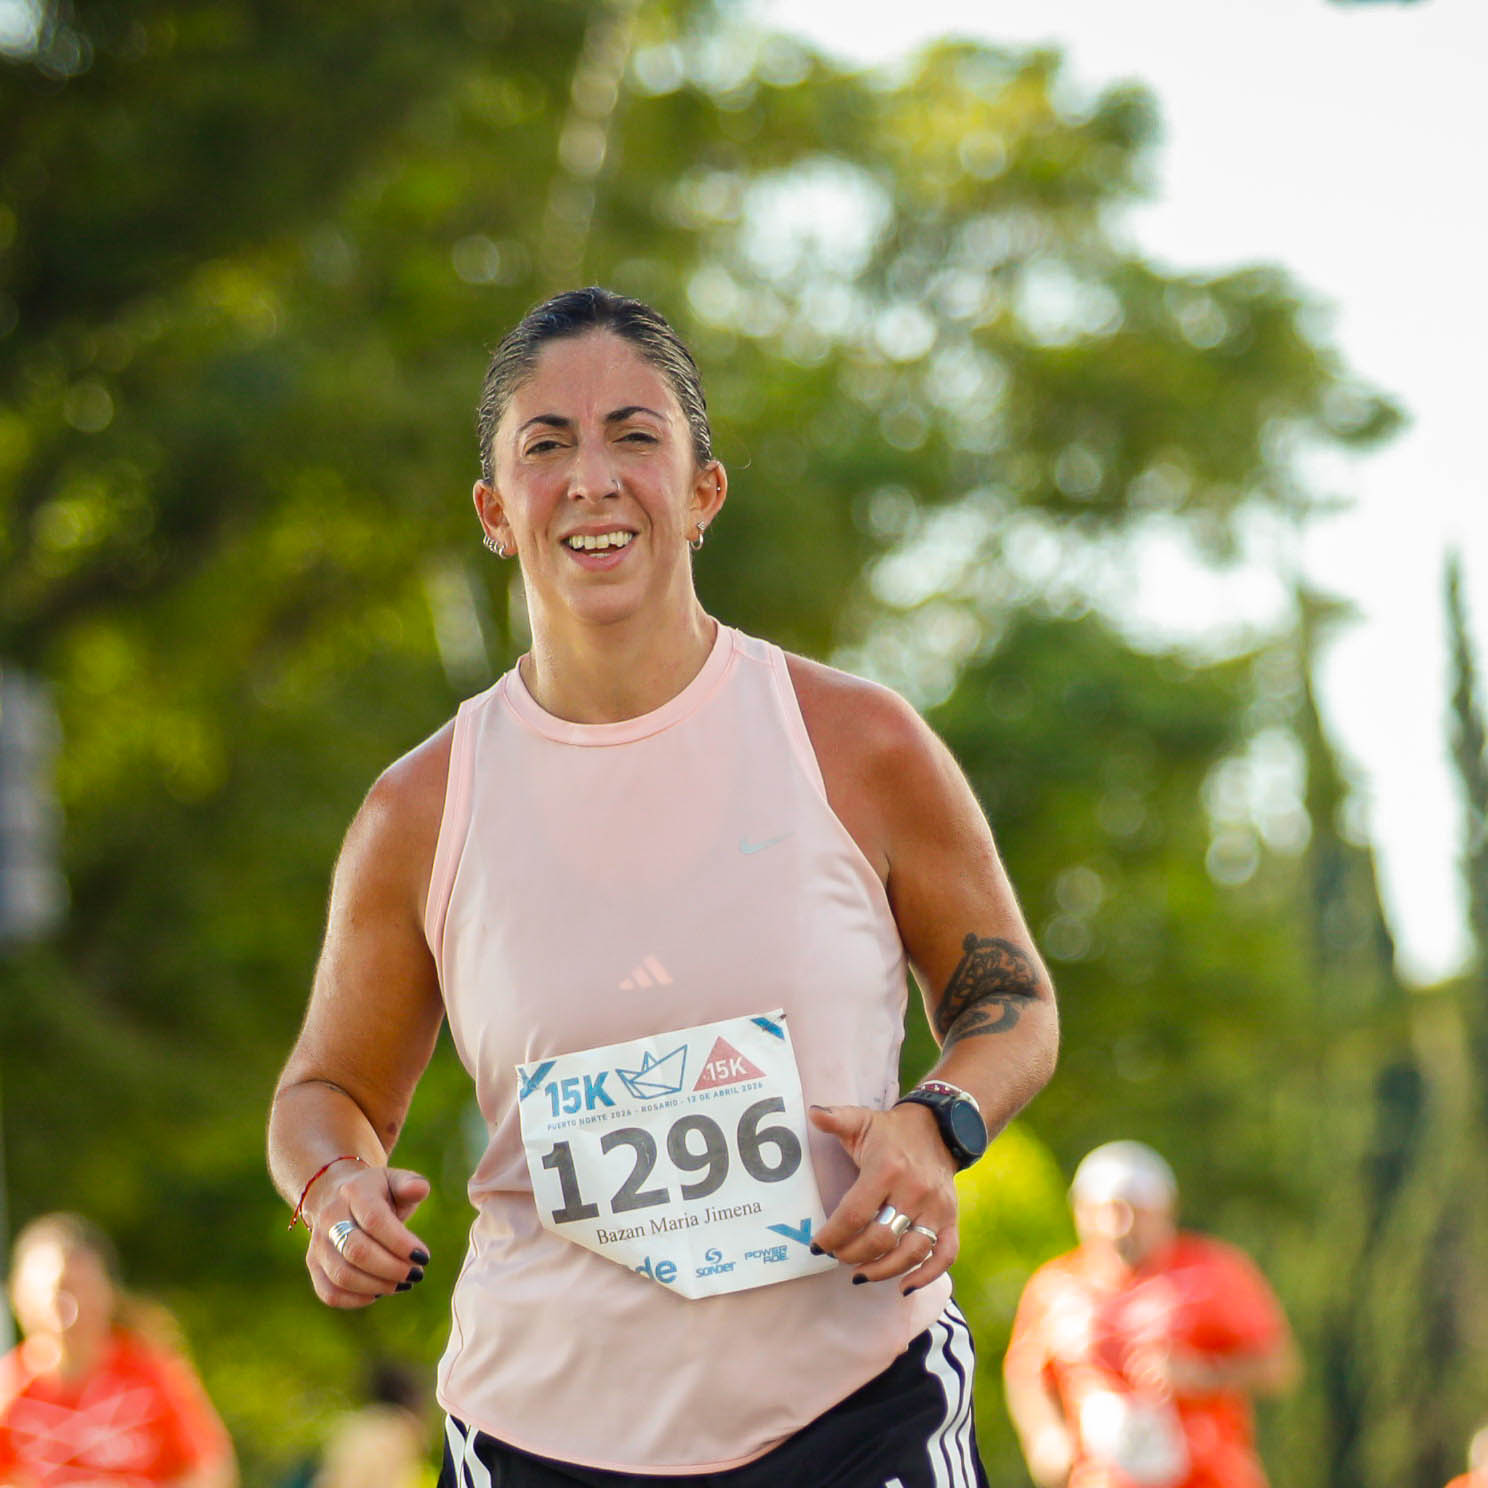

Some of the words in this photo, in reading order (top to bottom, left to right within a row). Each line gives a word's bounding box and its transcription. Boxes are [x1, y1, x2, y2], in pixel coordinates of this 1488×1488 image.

[706, 1056, 748, 1082] 15K
[544, 1070, 616, 1118] 15K
[547, 1119, 577, 1131] PUERTO
[579, 1113, 607, 1125] NORTE
[641, 1099, 678, 1112] ROSARIO
[713, 1087, 739, 1098] ABRIL
[541, 1096, 802, 1225] 1296
[596, 1224, 646, 1245] Bazan
[649, 1212, 699, 1235] Maria
[704, 1202, 762, 1225] Jimena
